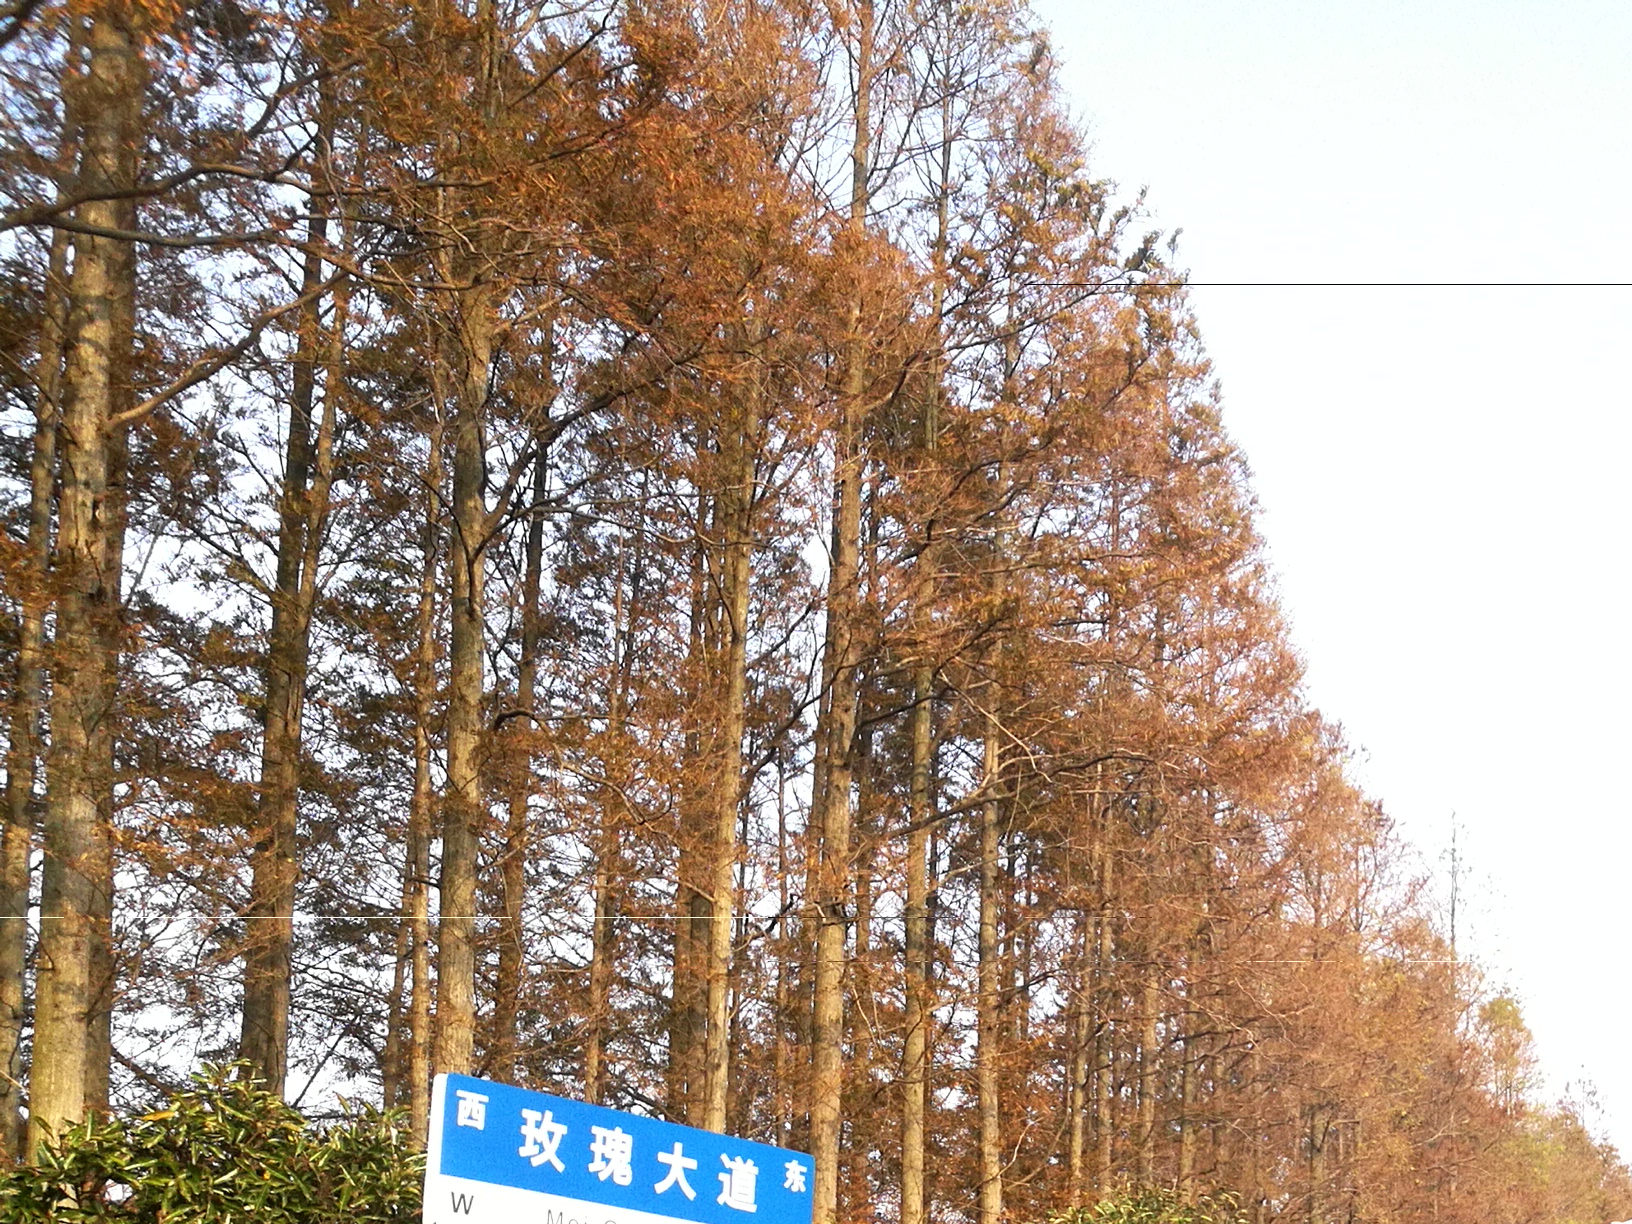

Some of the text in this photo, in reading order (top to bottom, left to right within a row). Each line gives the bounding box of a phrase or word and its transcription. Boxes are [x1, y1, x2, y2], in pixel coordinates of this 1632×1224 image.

[456, 1089, 489, 1131] 西
[518, 1108, 759, 1212] 玫瑰大道
[783, 1159, 808, 1193] 东
[450, 1191, 474, 1216] W
